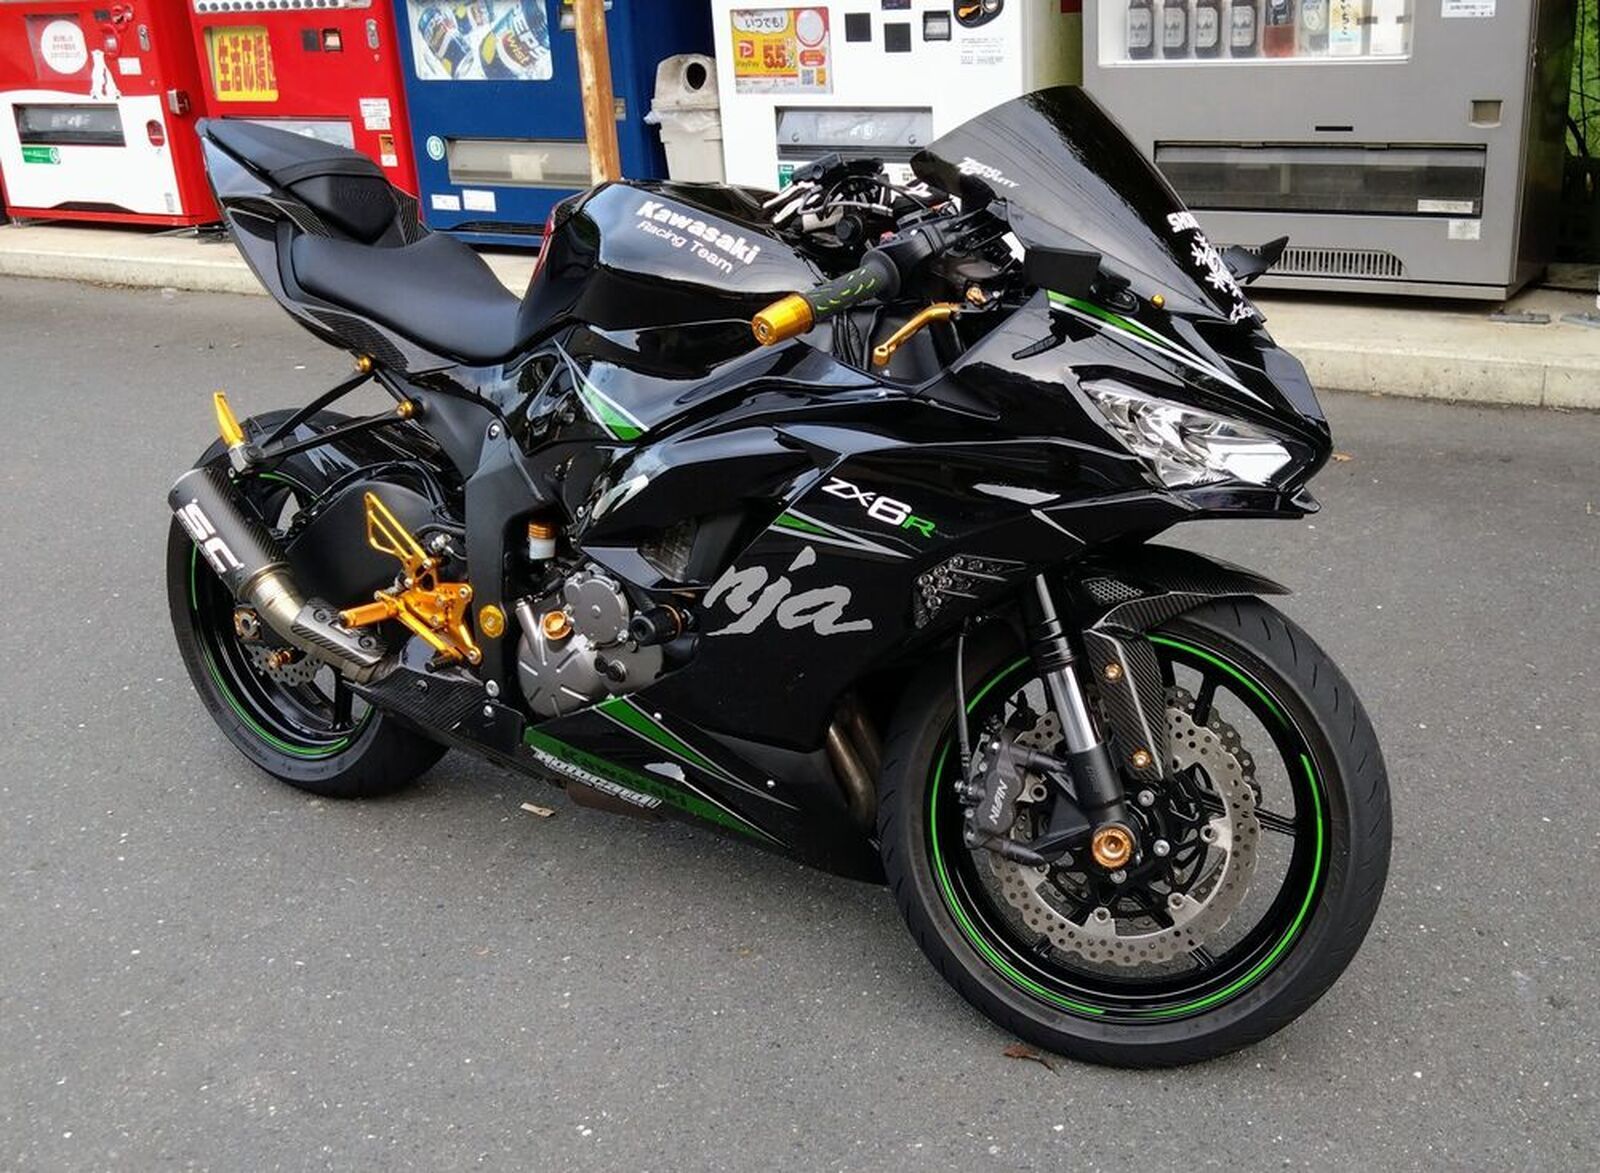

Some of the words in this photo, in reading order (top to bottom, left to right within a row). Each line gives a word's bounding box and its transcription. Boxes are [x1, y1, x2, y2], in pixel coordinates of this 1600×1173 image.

[636, 201, 761, 264] Kawasaki
[636, 221, 688, 248] Racing
[690, 240, 733, 274] Team
[821, 477, 936, 538] ZX-6R
